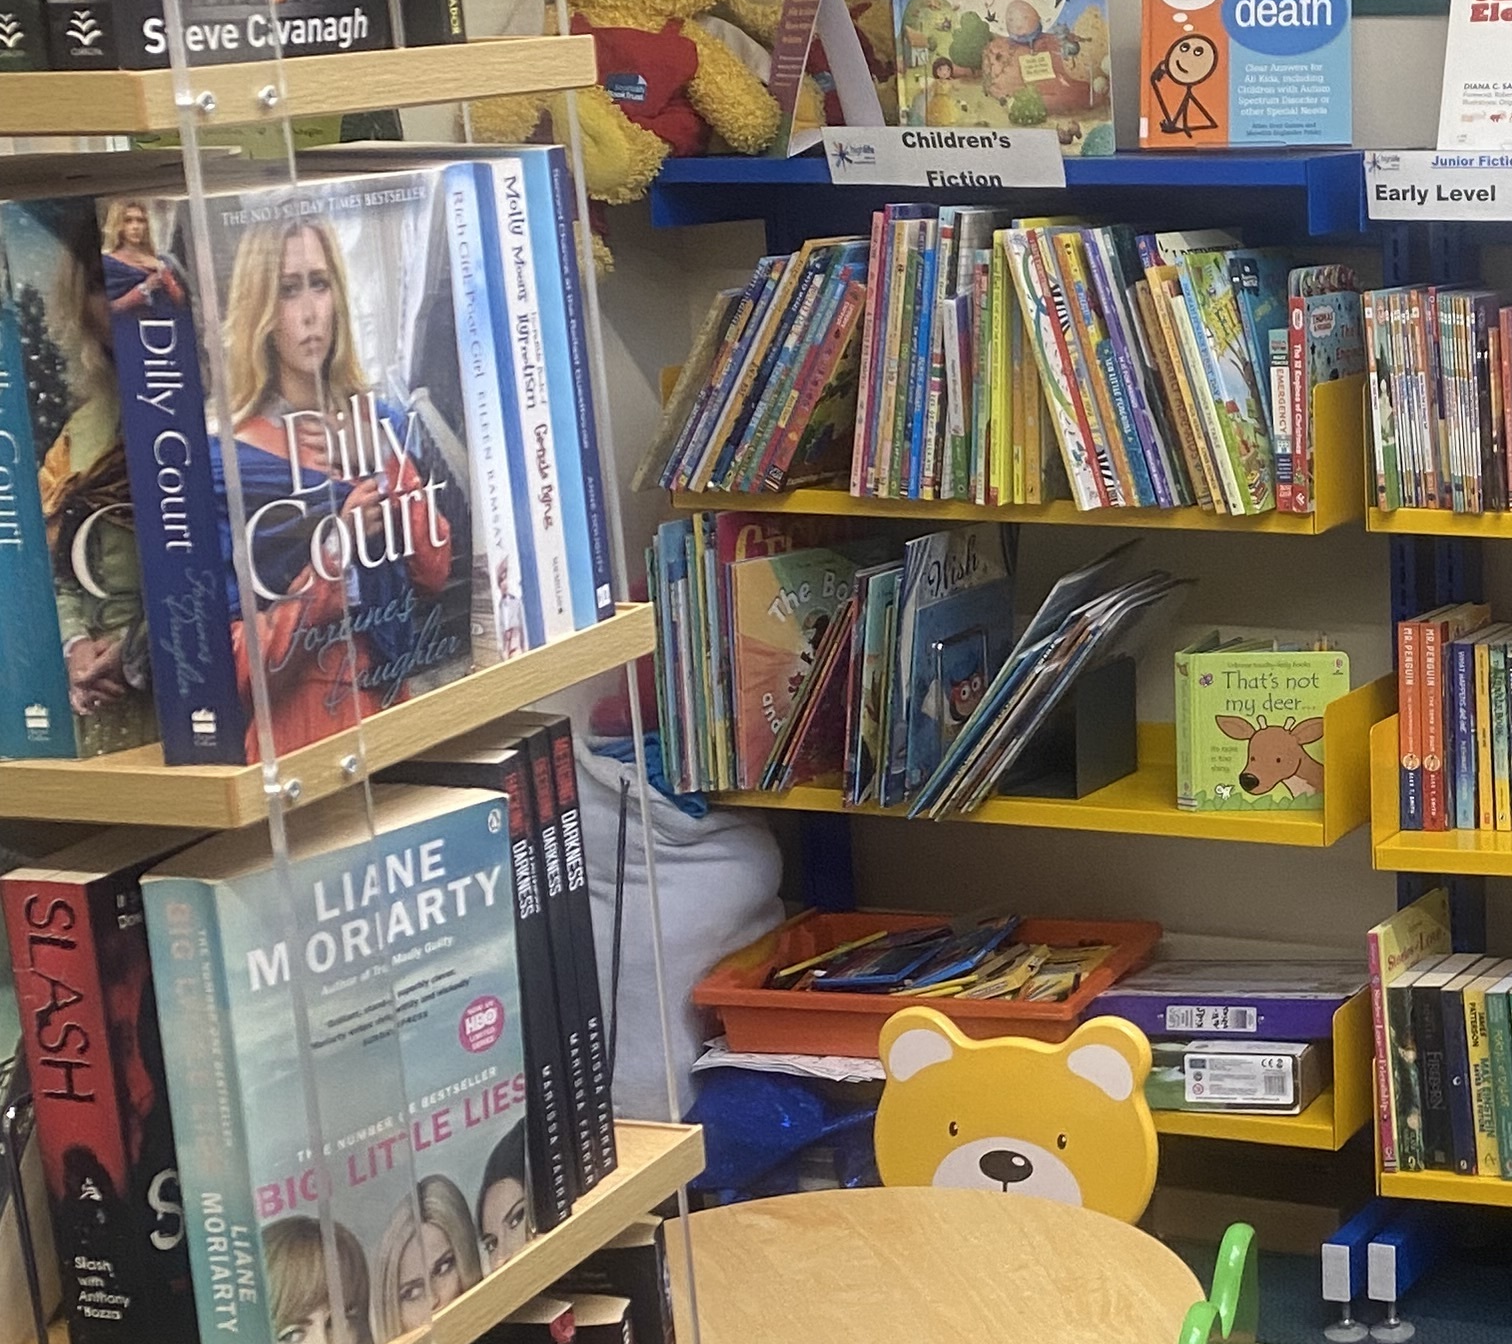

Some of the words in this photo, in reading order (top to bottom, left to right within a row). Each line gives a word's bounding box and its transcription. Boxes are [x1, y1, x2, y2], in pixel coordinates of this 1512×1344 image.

[901, 131, 1011, 150] Children's
[926, 170, 1003, 188] Fiction
[1431, 155, 1478, 170] Junior
[1375, 185, 1431, 204] Early
[1435, 185, 1496, 202] Level
[136, 317, 191, 418] Dilly
[284, 391, 419, 500] Dilly
[152, 431, 192, 555] Court
[243, 476, 451, 605] Court
[1221, 669, 1279, 691] That's
[1283, 672, 1320, 689] not
[1225, 695, 1253, 716] my
[314, 838, 446, 922] LIANE
[560, 809, 585, 891] DARKNESS
[246, 866, 501, 991] MORIARTY
[22, 891, 97, 1107] SLASH
[200, 1192, 237, 1334] MORIARTY
[231, 1224, 256, 1305] LIANE
